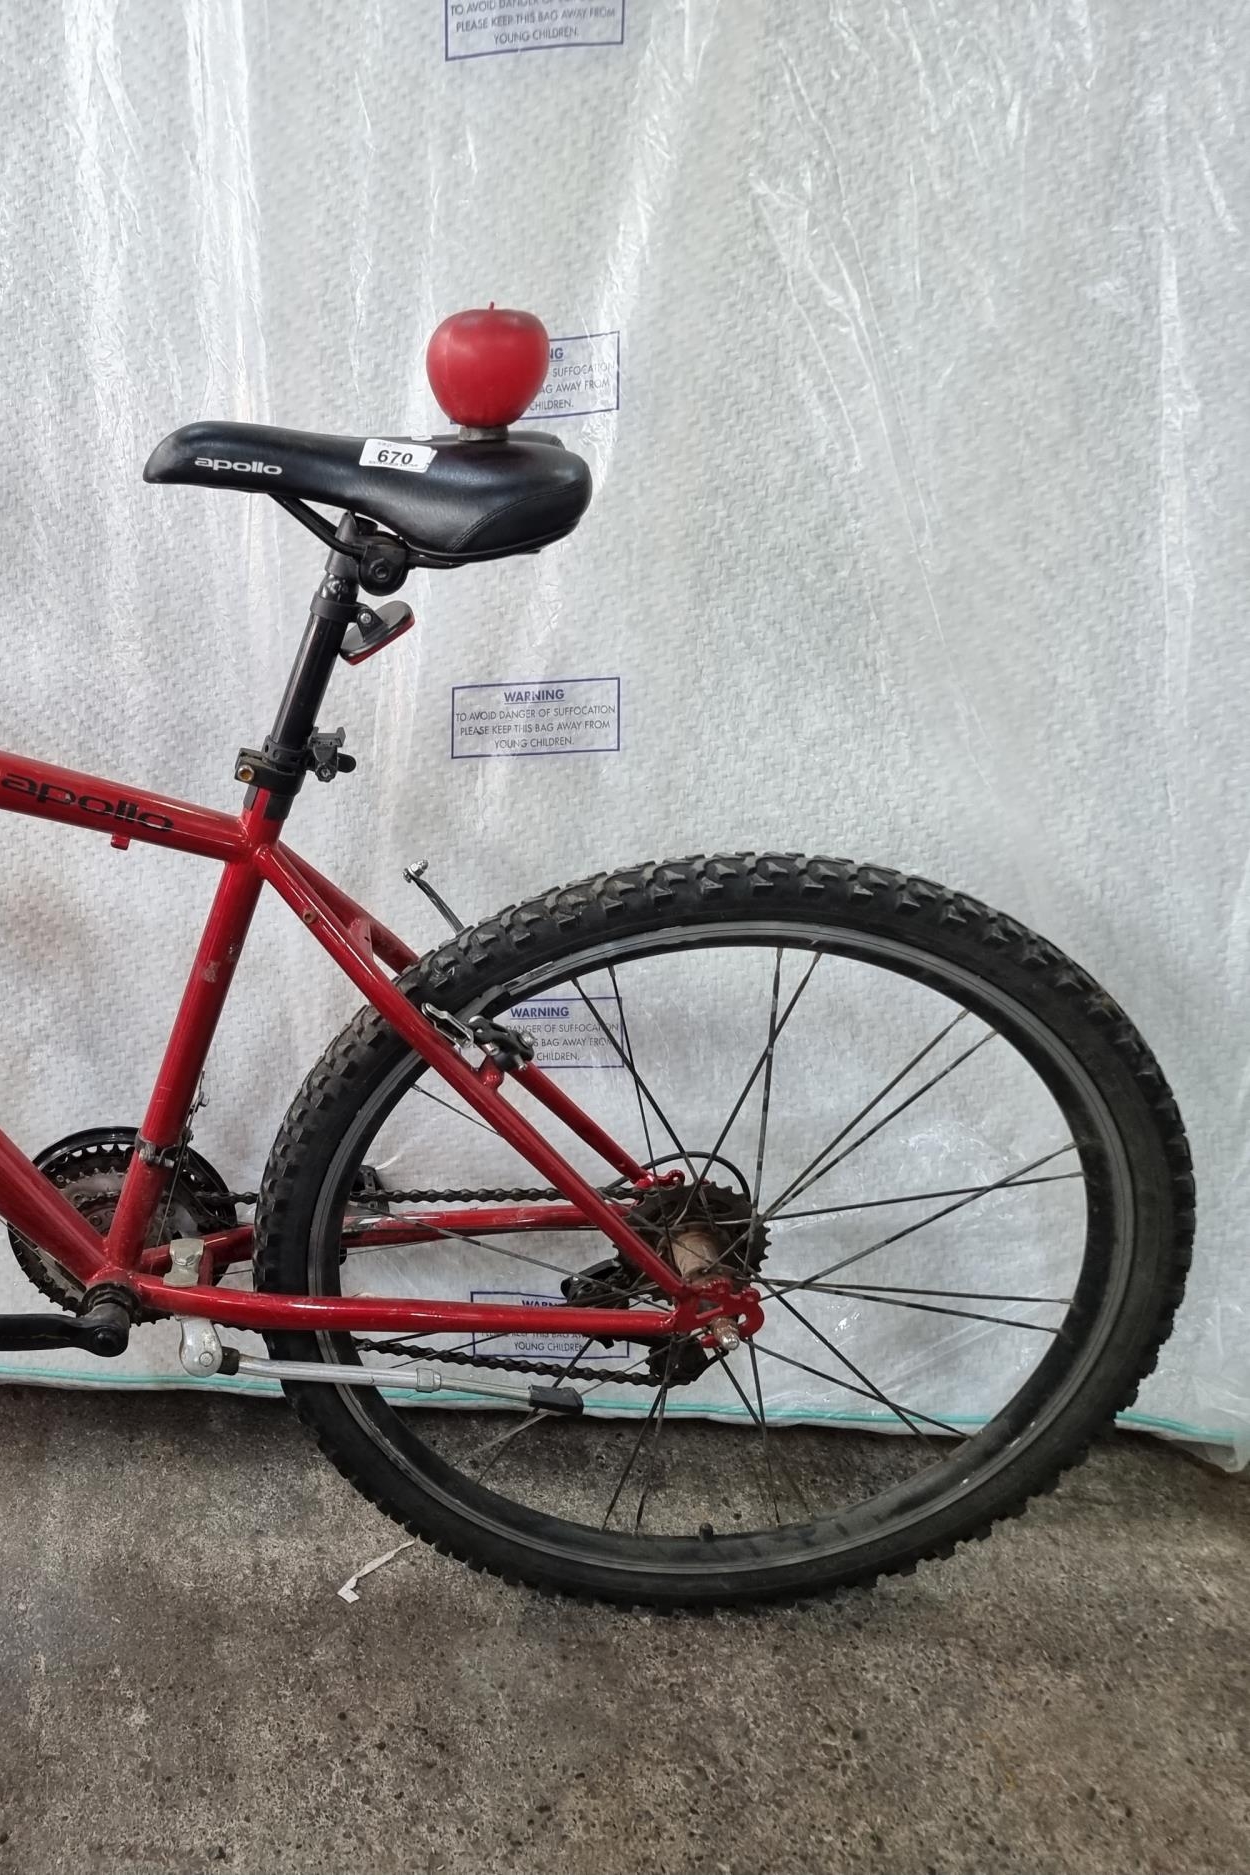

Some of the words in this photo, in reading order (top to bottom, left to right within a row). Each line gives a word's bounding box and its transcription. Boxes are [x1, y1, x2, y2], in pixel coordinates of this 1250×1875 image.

[451, 4, 464, 16] TO
[466, 0, 496, 14] AVOID
[456, 17, 489, 33] PLEASE
[491, 14, 513, 27] KEEP
[515, 11, 535, 24] THIS
[538, 9, 558, 22] BAG
[561, 8, 587, 20] AWAY
[493, 31, 530, 45] YOUNG
[552, 361, 616, 378] SUFFOCATION
[555, 381, 582, 393] AWAY
[584, 377, 610, 391] FROM
[377, 449, 414, 465] 670
[194, 456, 284, 477] apollo
[503, 688, 565, 703] WARNING
[455, 712, 468, 722] TO
[469, 710, 497, 721] AVOID
[499, 708, 536, 720] DANGER
[538, 708, 551, 718] OF
[553, 704, 616, 717] SUFFOCATION
[460, 725, 490, 736] PLEASE
[492, 724, 512, 735] KEEP
[514, 723, 533, 734] THIS
[535, 722, 554, 733] BAG
[556, 720, 583, 732] AWAY
[584, 719, 611, 730] FROM
[495, 738, 528, 749] YOUNG
[0, 772, 175, 833] apollo
[510, 1006, 571, 1019] WARNING
[544, 1024, 557, 1033] OF
[558, 1022, 619, 1033] SUFFOCAON
[541, 1038, 560, 1047] BAG
[562, 1037, 588, 1046] AWAY
[514, 1341, 545, 1351] YOUNG
